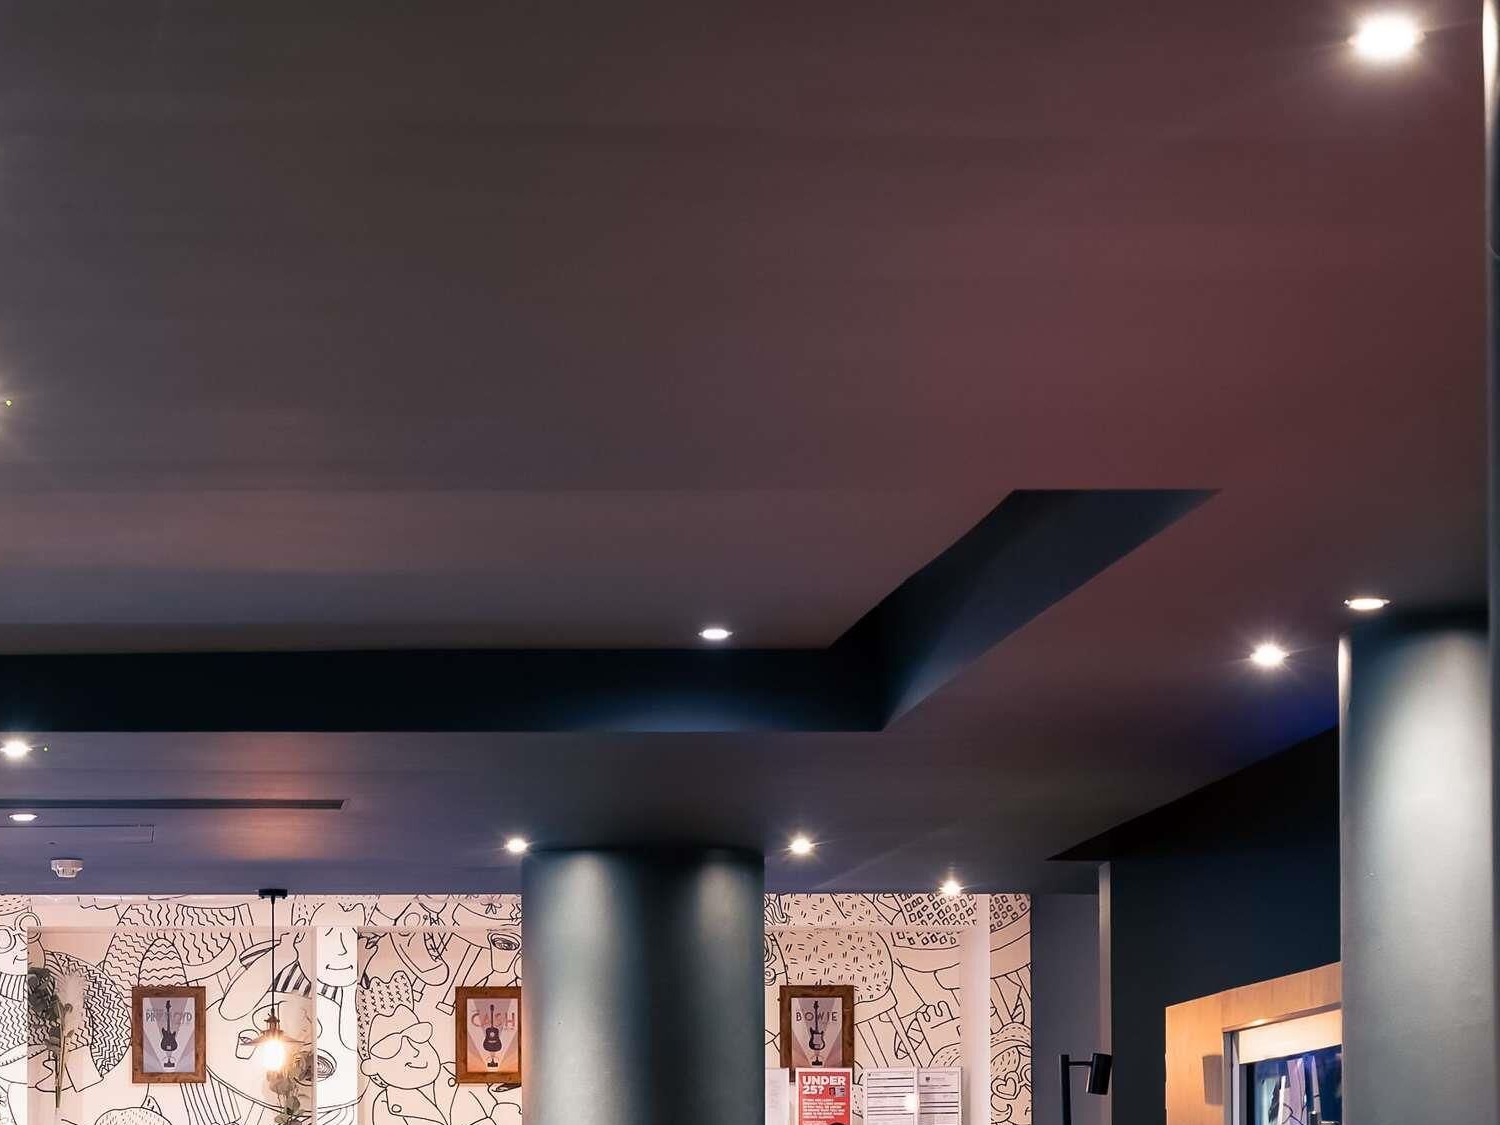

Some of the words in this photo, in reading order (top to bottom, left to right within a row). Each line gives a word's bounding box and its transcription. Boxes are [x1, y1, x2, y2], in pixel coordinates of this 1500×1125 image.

[796, 1011, 838, 1022] BOWIE
[802, 1075, 846, 1086] UNDER
[802, 1085, 825, 1095] 25?
